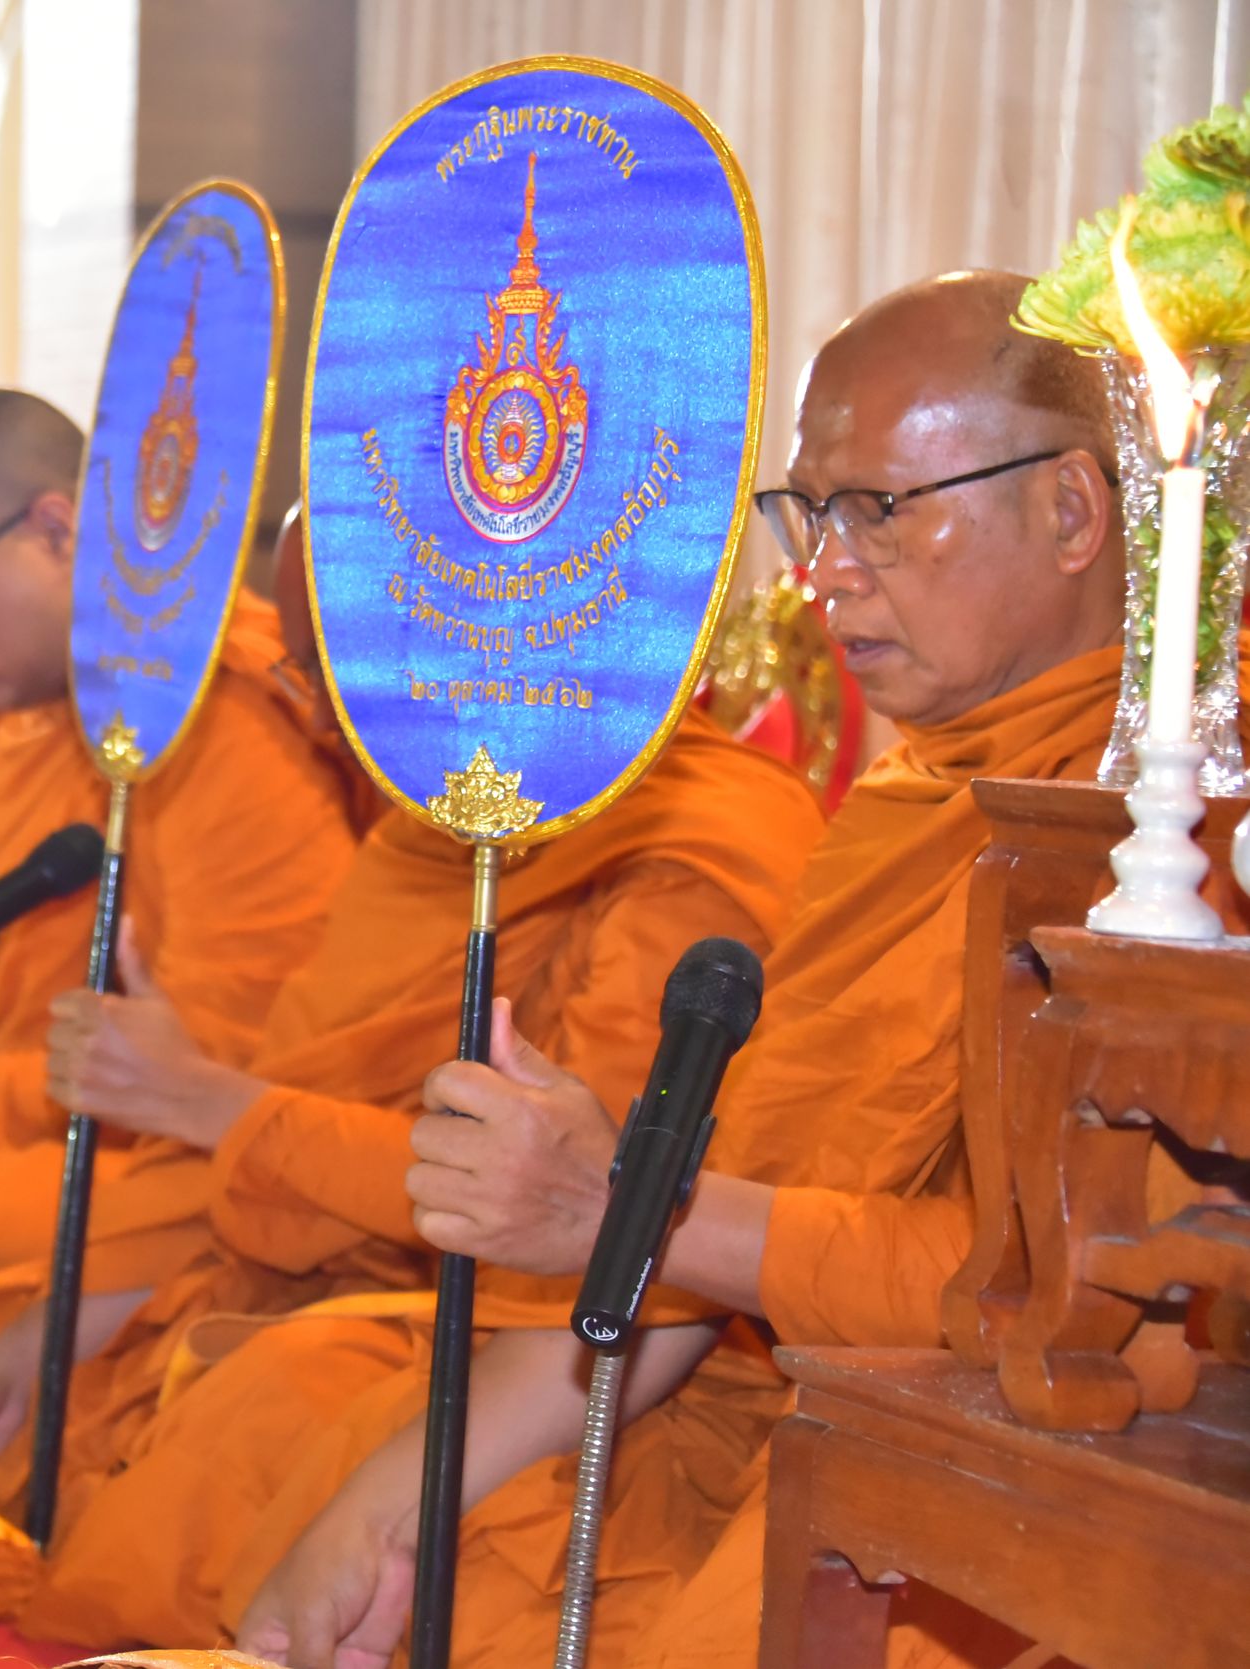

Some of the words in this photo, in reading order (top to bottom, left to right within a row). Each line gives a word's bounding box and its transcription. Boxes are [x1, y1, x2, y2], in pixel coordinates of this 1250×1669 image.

[436, 105, 639, 182] พระกฐินพระราชทาน
[362, 426, 682, 601] มหาวิทยาลัยเทคโนโลยีราชมงคลธัญบุรี
[388, 573, 408, 604] ณ
[524, 562, 628, 656] จ.ปทุมธานี
[448, 680, 513, 716] ตุลาคม
